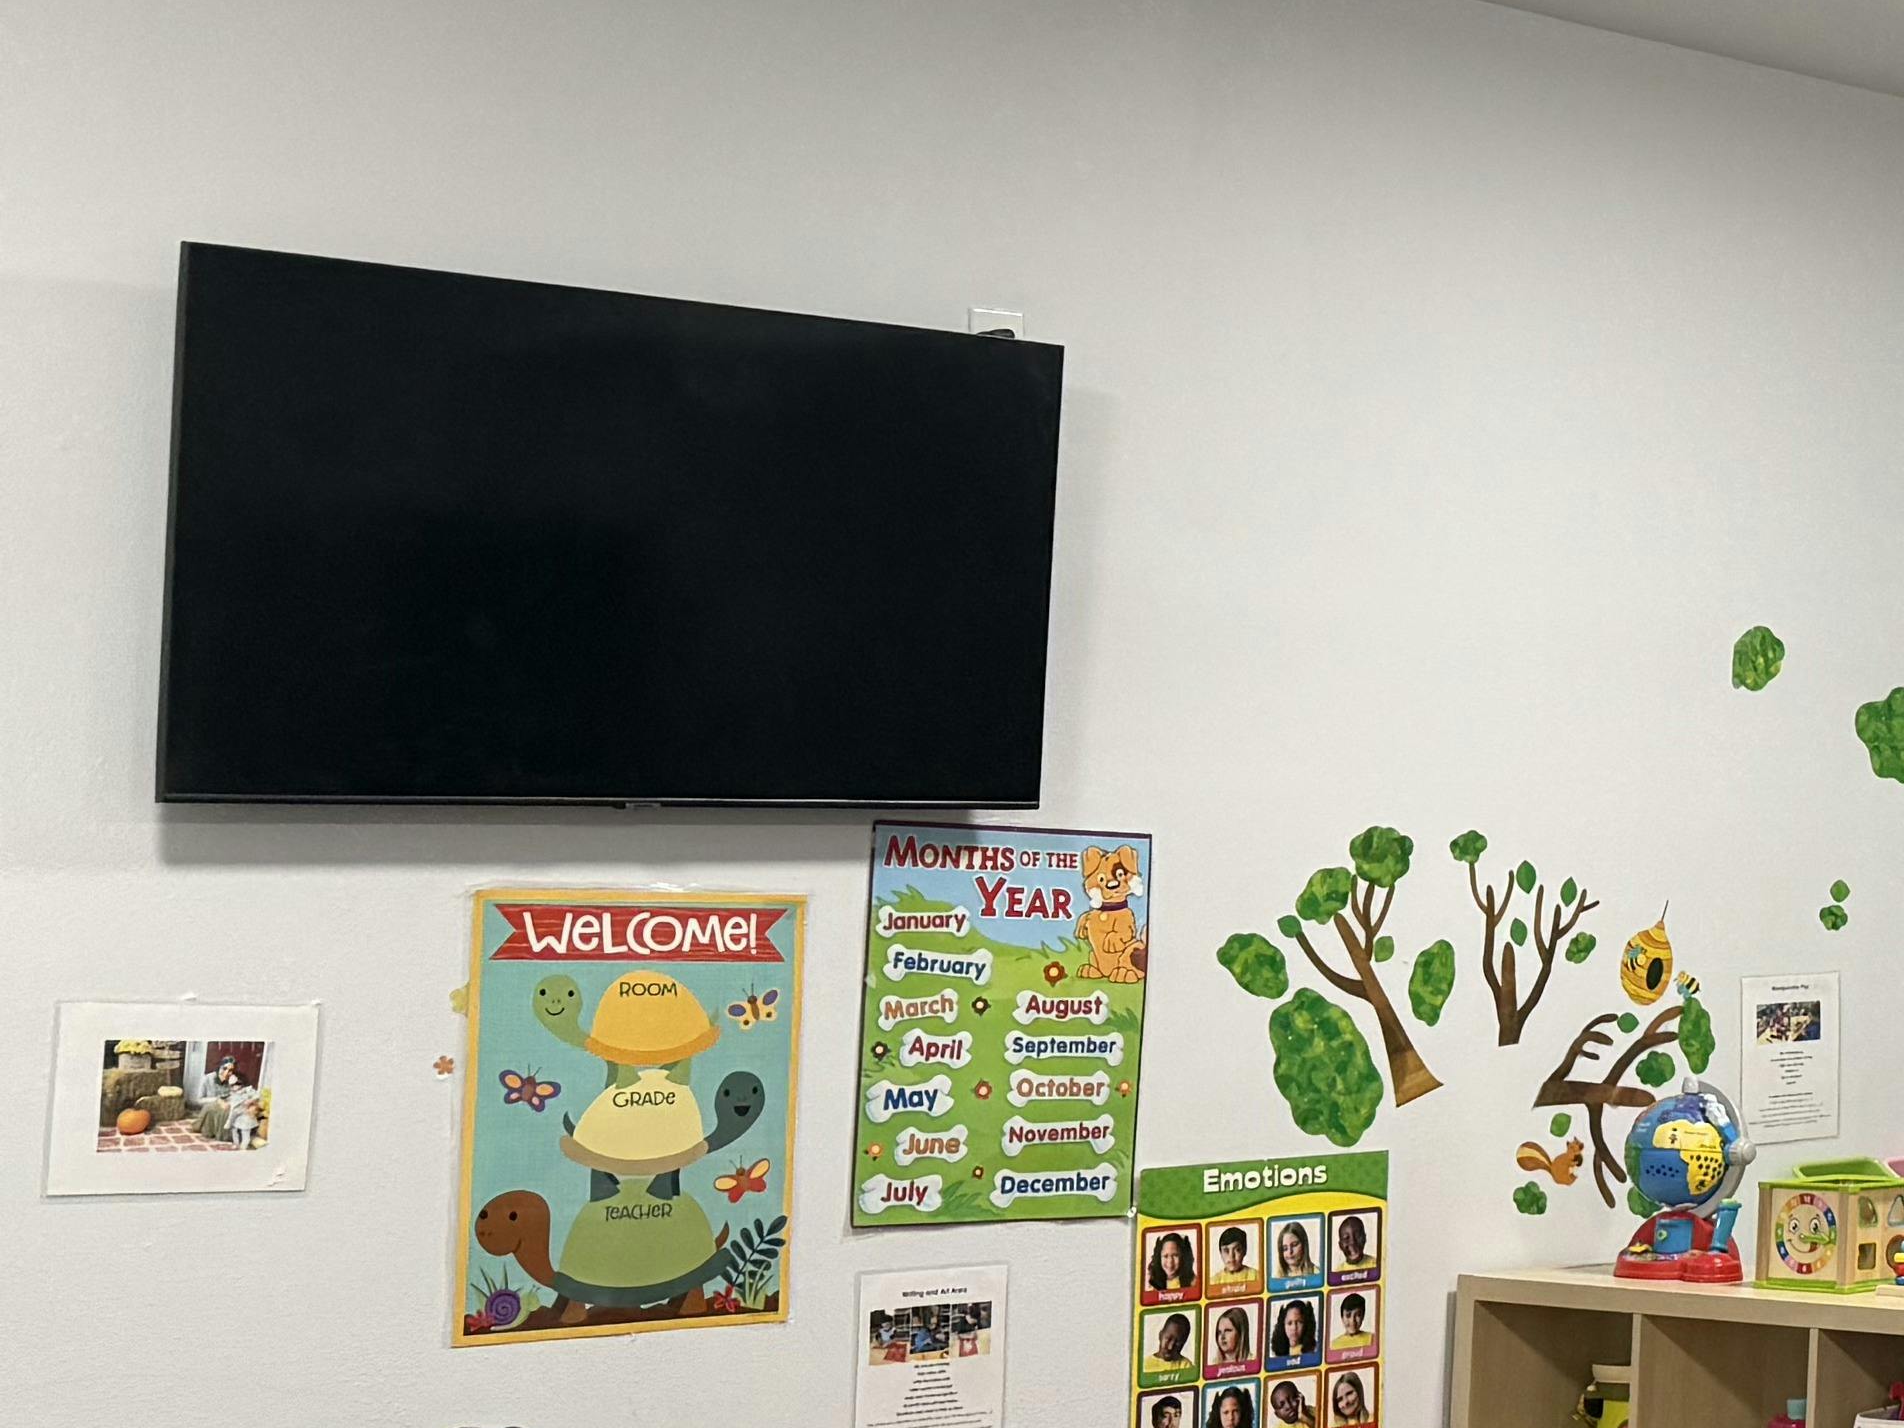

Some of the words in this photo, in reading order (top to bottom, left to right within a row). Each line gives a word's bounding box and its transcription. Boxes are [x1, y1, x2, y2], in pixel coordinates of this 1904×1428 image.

[884, 834, 1015, 871] MONTHS
[1020, 851, 1041, 868] OF
[1046, 852, 1078, 869] THE
[975, 875, 1074, 920] YEAR
[883, 912, 967, 933] January
[893, 951, 986, 980] February
[619, 981, 678, 998] ROOM
[884, 994, 955, 1019] March
[1025, 994, 1103, 1018] August
[908, 1036, 963, 1061] April
[1012, 1037, 1117, 1058] September
[883, 1087, 939, 1112] May
[1016, 1078, 1105, 1098] October
[902, 1134, 961, 1156] June
[1008, 1123, 1110, 1144] November
[1000, 1172, 1111, 1195] December
[1202, 1164, 1328, 1194] Emotions
[881, 1180, 929, 1206] July
[1158, 1290, 1185, 1303] happy
